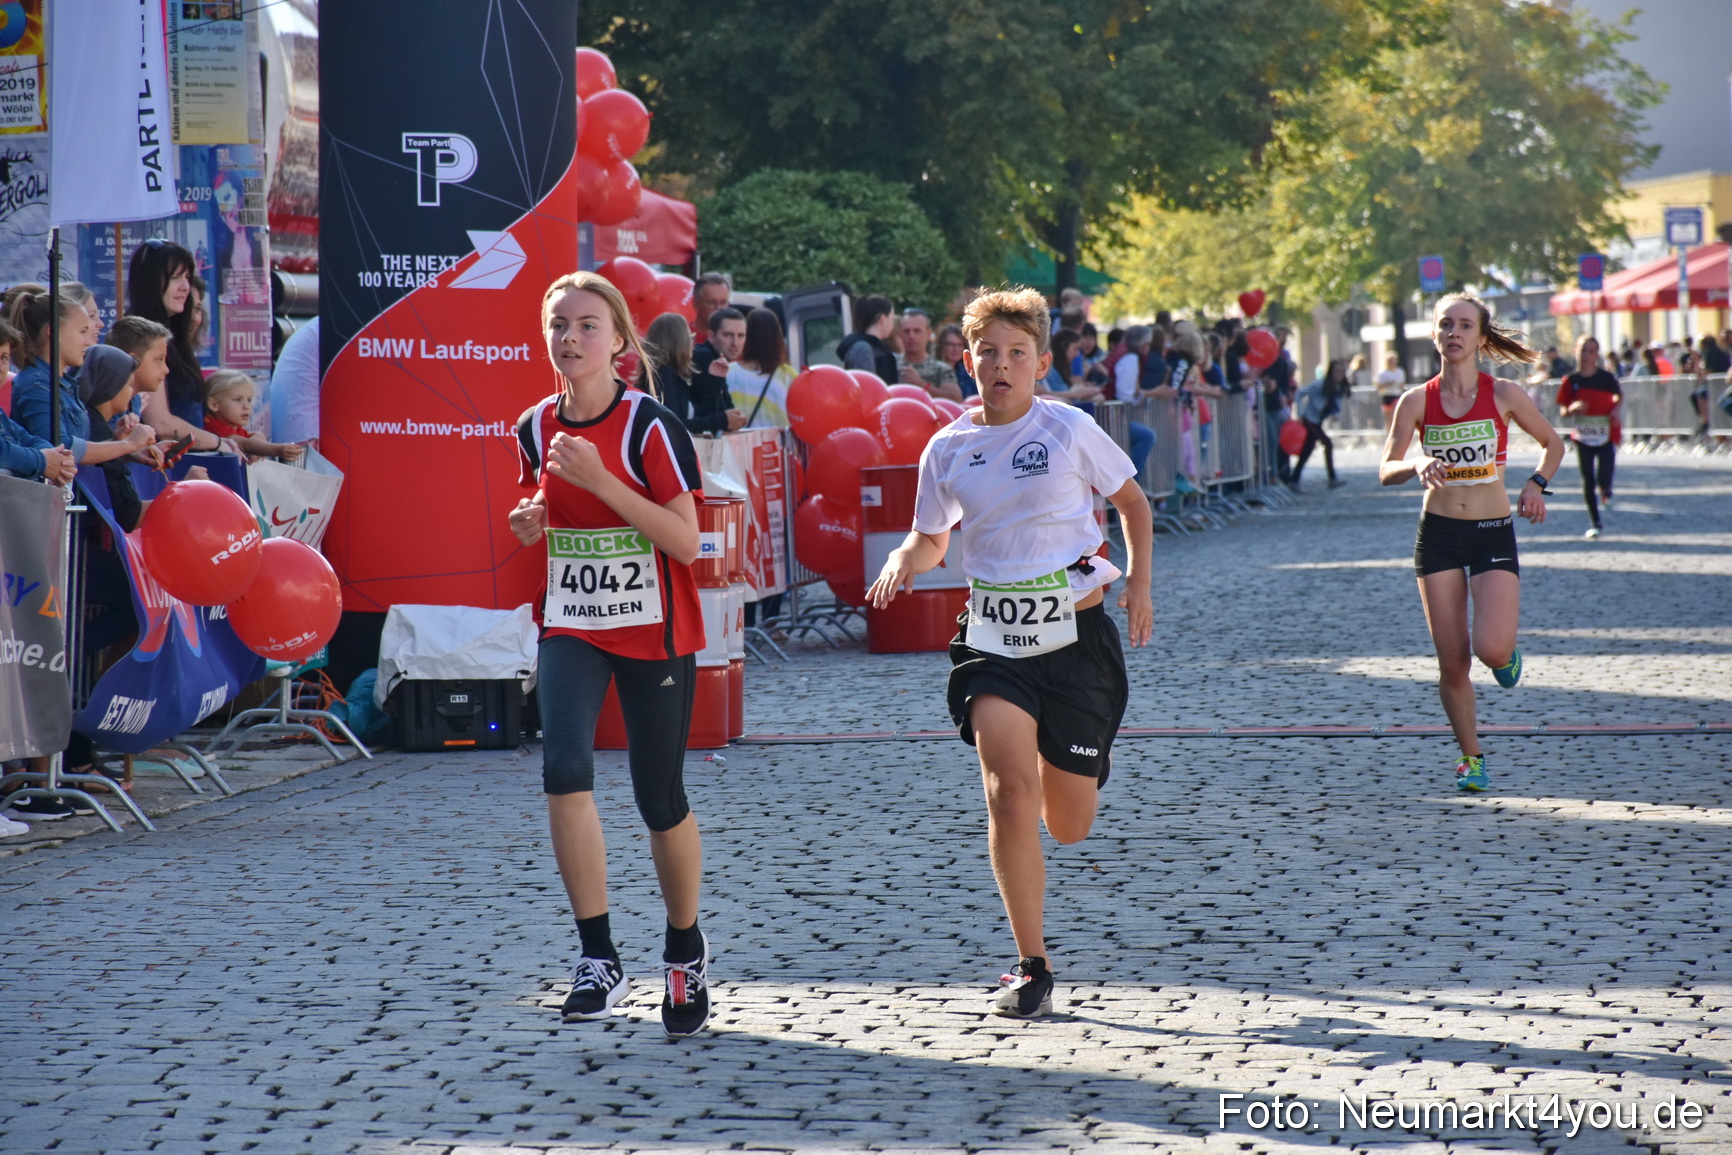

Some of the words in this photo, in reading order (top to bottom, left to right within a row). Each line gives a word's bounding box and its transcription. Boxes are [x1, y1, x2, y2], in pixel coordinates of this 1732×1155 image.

[170, 57, 179, 87] andere
[0, 77, 36, 91] 2019
[170, 88, 179, 105] und
[2, 104, 33, 114] Wölpi
[18, 115, 33, 123] Uhr
[172, 107, 180, 141] Kakteen
[407, 138, 429, 147] Team
[431, 138, 450, 147] Partl
[184, 186, 213, 202] 2019
[381, 255, 411, 271] THE
[416, 255, 460, 271] NEXT
[357, 272, 382, 287] 100
[384, 272, 439, 288] YEARS
[358, 338, 414, 358] BMW
[420, 339, 530, 364] Laufsport
[1429, 425, 1487, 442] BOCK
[1431, 444, 1487, 464] 5001
[1447, 468, 1488, 480] ANESSA
[1477, 520, 1503, 528] NIKE
[557, 533, 641, 554] BOCK
[560, 562, 643, 594] 4042
[563, 601, 643, 617] MARLEEN
[982, 596, 1061, 625] 4022
[1003, 634, 1040, 646] ERIK
[1070, 745, 1098, 757] JAKO
